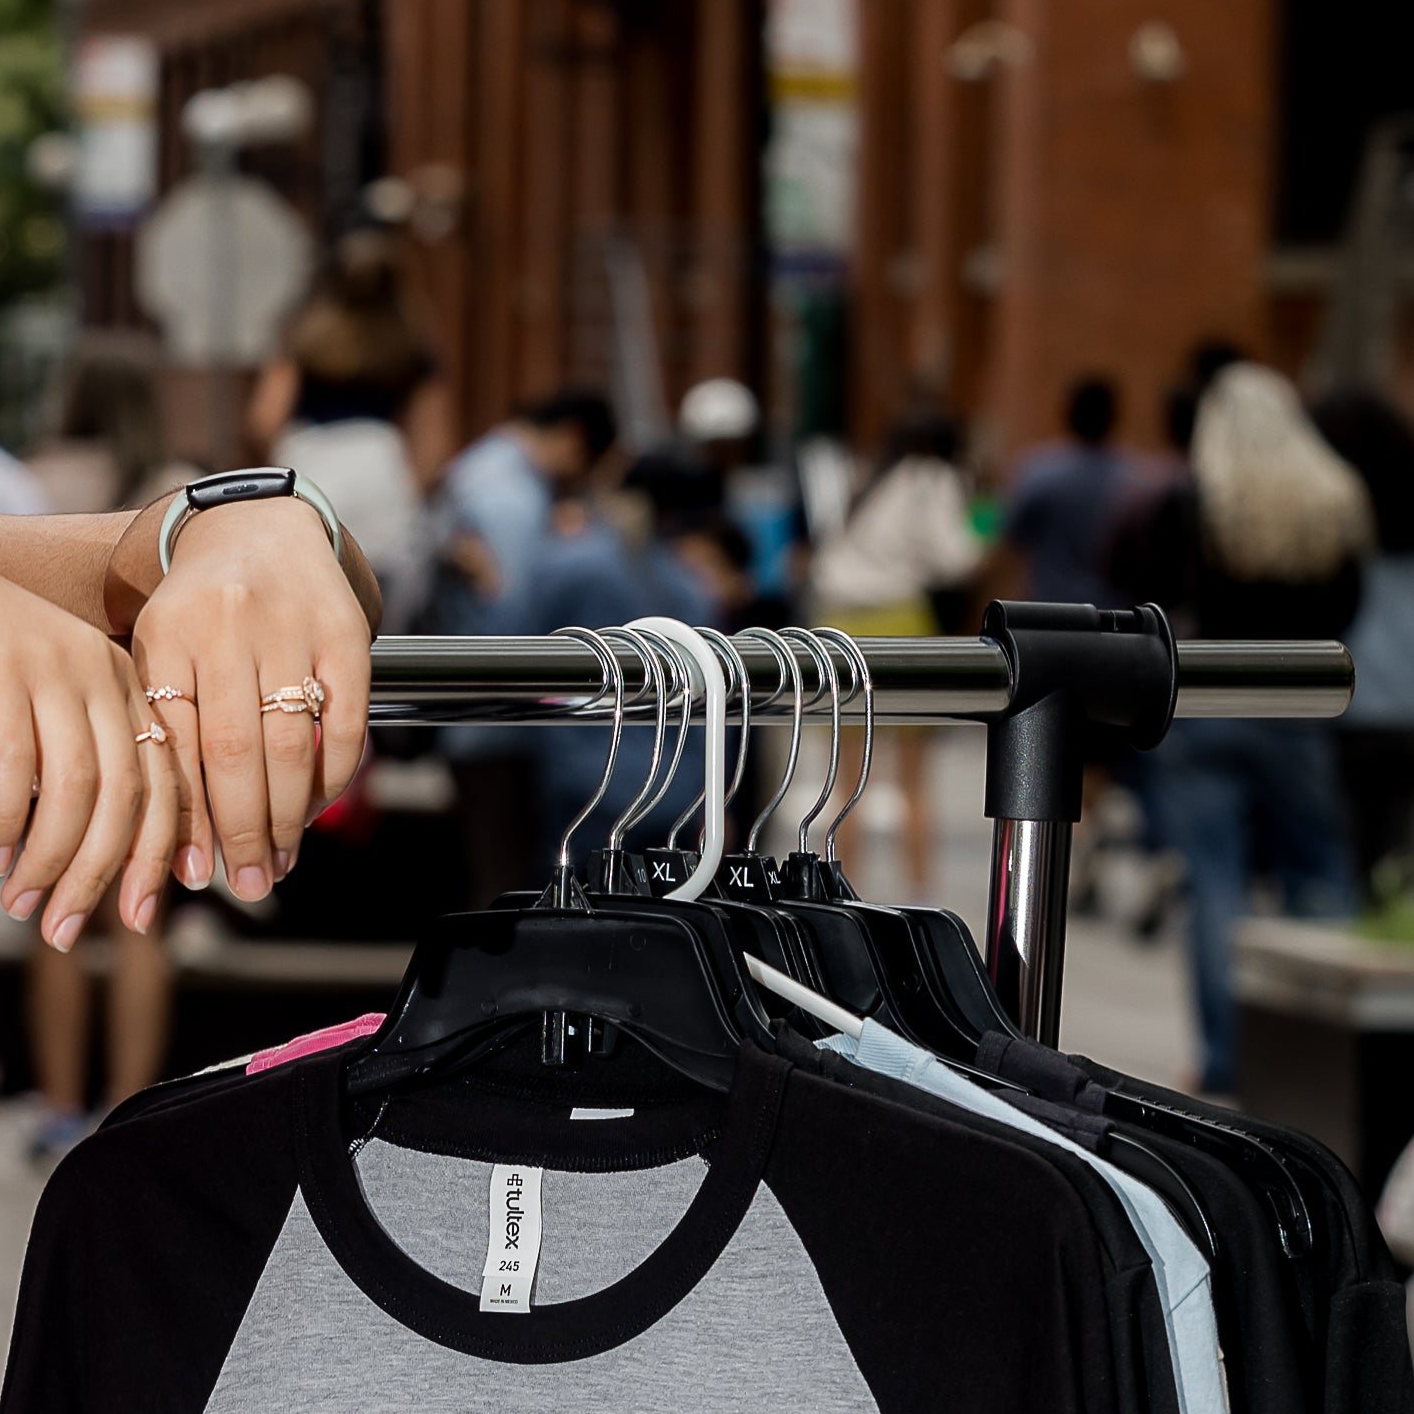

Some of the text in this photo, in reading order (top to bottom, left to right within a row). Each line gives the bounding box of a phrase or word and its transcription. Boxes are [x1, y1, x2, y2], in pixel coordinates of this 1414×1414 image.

[652, 861, 676, 882] XL
[729, 866, 754, 888] XL
[768, 870, 782, 885] XL
[505, 1188, 525, 1250] tultex
[499, 1260, 520, 1272] 245
[500, 1283, 512, 1296] M
